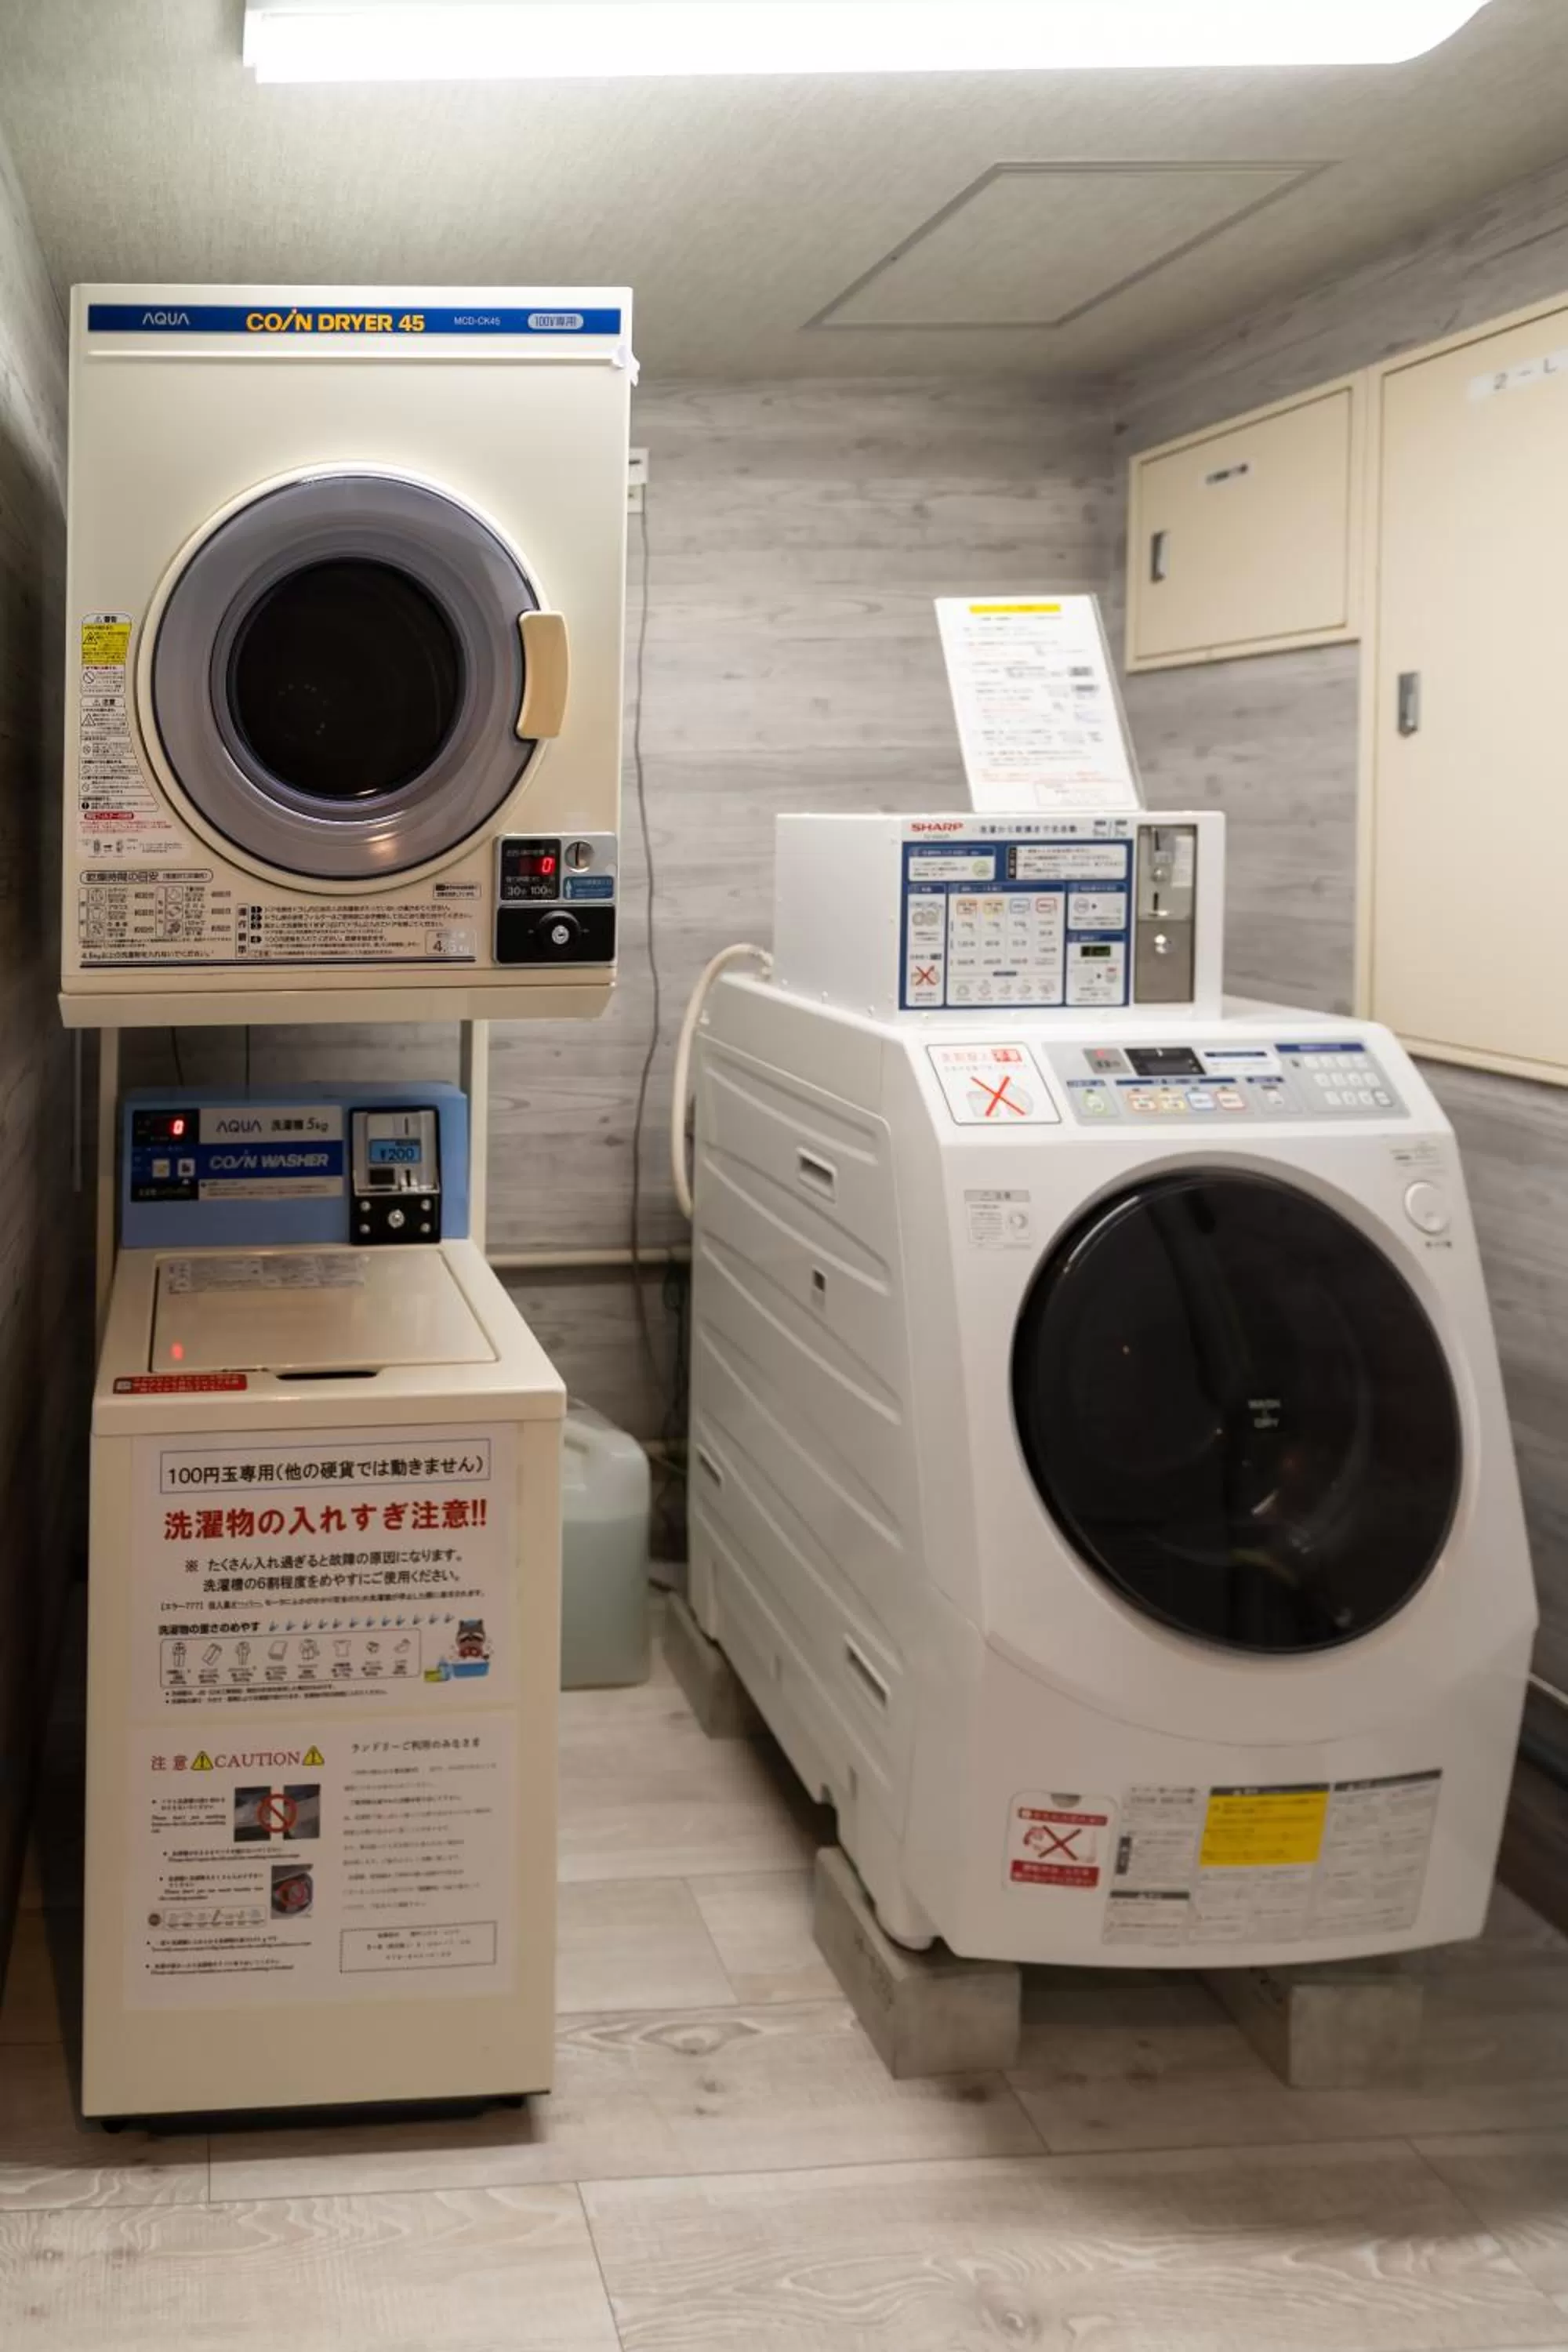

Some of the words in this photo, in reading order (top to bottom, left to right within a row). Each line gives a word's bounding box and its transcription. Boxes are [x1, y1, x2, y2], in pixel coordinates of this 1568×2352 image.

[142, 311, 191, 325] AQUA
[318, 313, 393, 332] DRYER
[398, 314, 426, 332] 45
[910, 822, 964, 833] SHARP
[542, 857, 555, 873] 0
[216, 1119, 263, 1134] AQUA
[260, 1152, 330, 1169] WASHER
[214, 1751, 301, 1769] CAUTION
